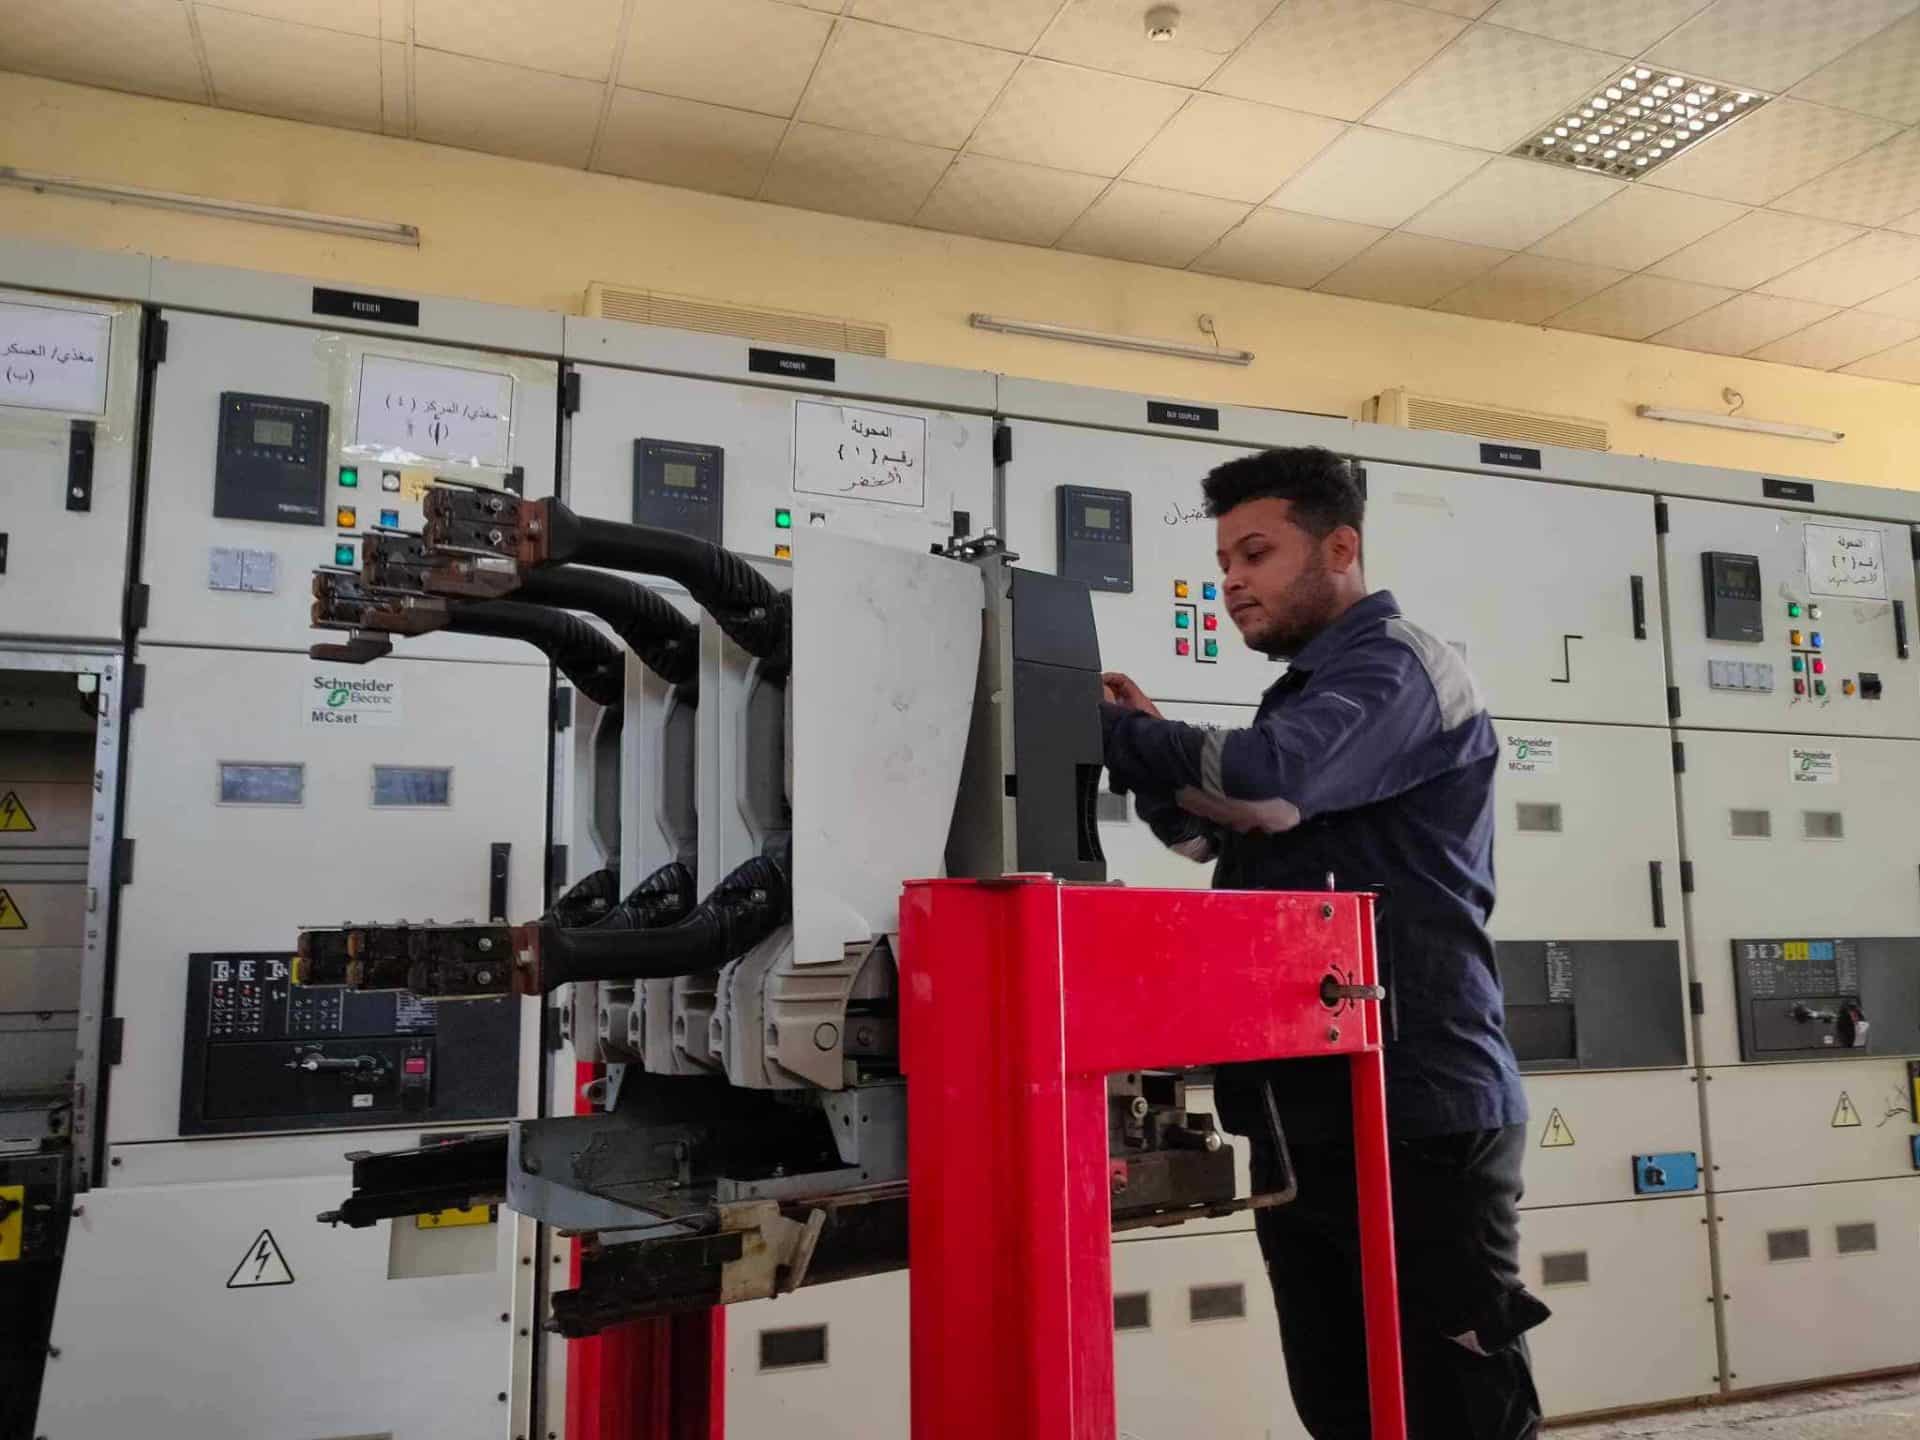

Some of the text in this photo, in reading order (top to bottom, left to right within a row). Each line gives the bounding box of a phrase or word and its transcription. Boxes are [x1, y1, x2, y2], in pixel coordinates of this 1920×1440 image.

[851, 419, 892, 440] المحولة
[313, 676, 394, 692] Schneider
[312, 711, 358, 724] MCset
[1507, 736, 1553, 747] Schneider
